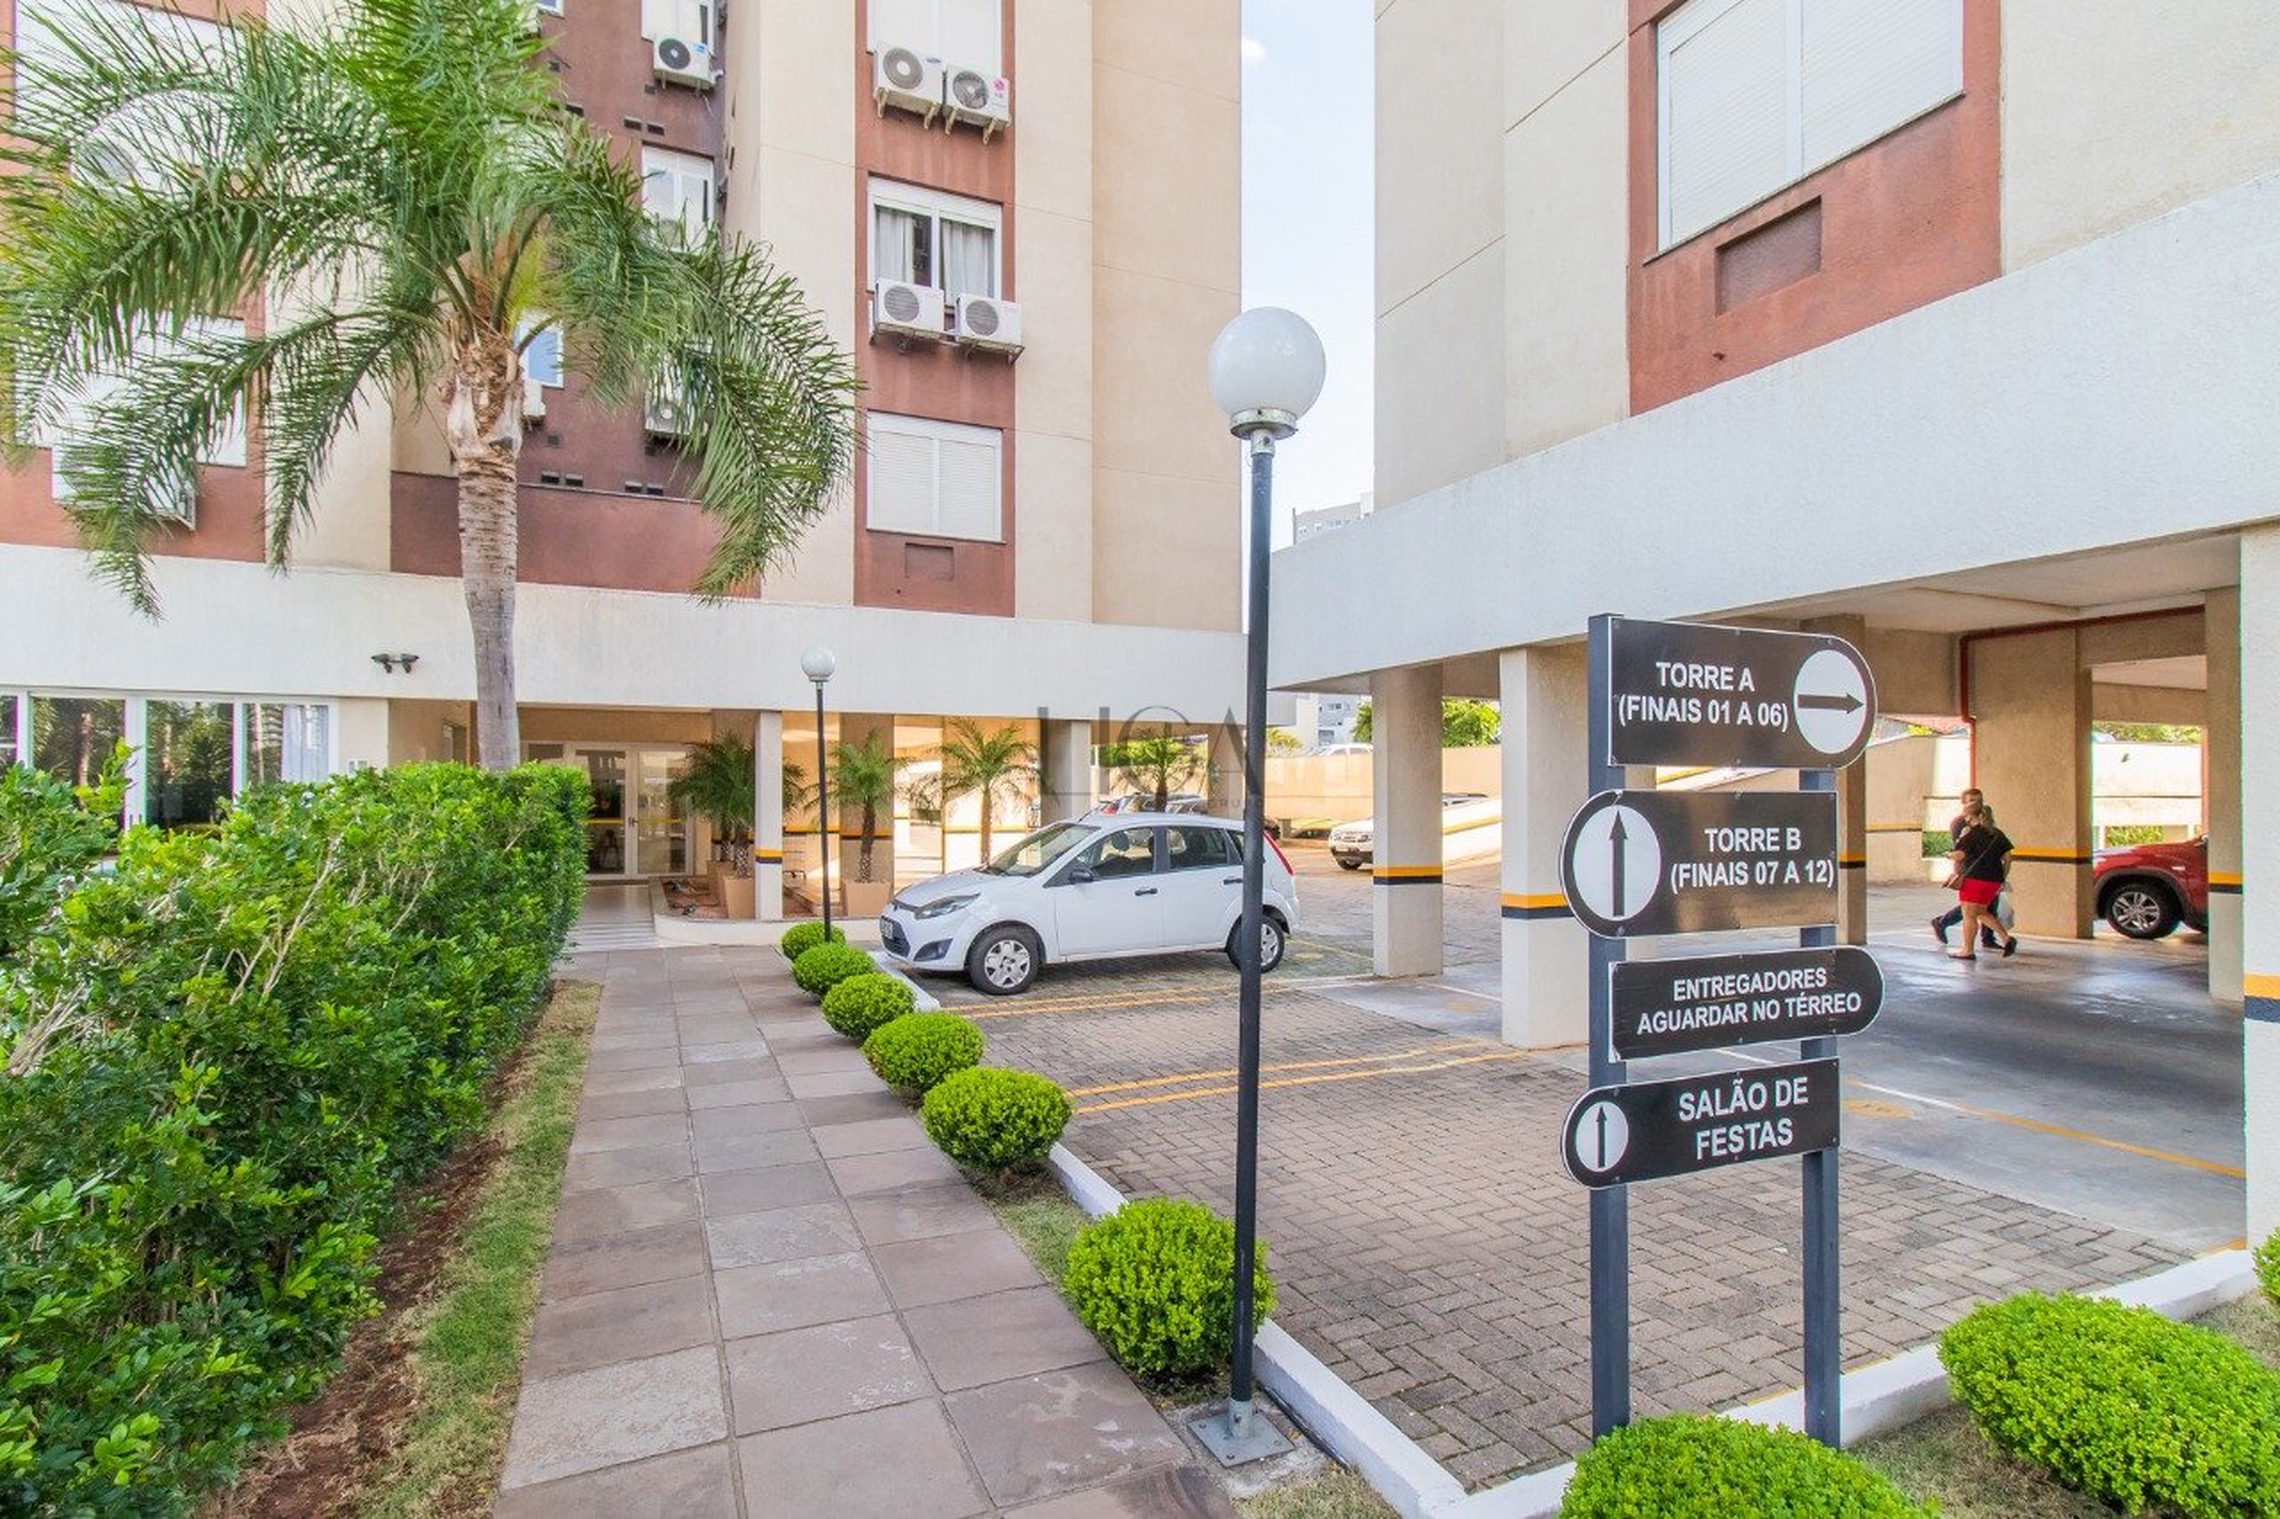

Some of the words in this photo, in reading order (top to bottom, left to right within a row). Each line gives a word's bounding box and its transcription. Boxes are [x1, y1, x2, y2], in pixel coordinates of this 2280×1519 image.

[1656, 662, 1734, 691] TORRE
[1738, 667, 1755, 692] A
[1618, 694, 1702, 727] (FINAIS
[1708, 699, 1731, 724] 01
[1737, 702, 1753, 725] A
[1757, 704, 1789, 732] 06)
[1704, 827, 1782, 852] TORRE
[1786, 827, 1802, 850] B
[1671, 863, 1750, 895] (FINAIS
[1755, 862, 1778, 885] 07
[1783, 860, 1800, 884] A
[1804, 859, 1835, 888] 12)
[1673, 967, 1828, 1002] ENTREGADORES
[1636, 1001, 1749, 1036] AGUARDAR
[1752, 998, 1780, 1022] NO
[1784, 991, 1862, 1018] TÉRREO
[1678, 1079, 1766, 1122] SALÃO
[1775, 1077, 1809, 1107] DE
[1696, 1118, 1794, 1160] FESTAS
